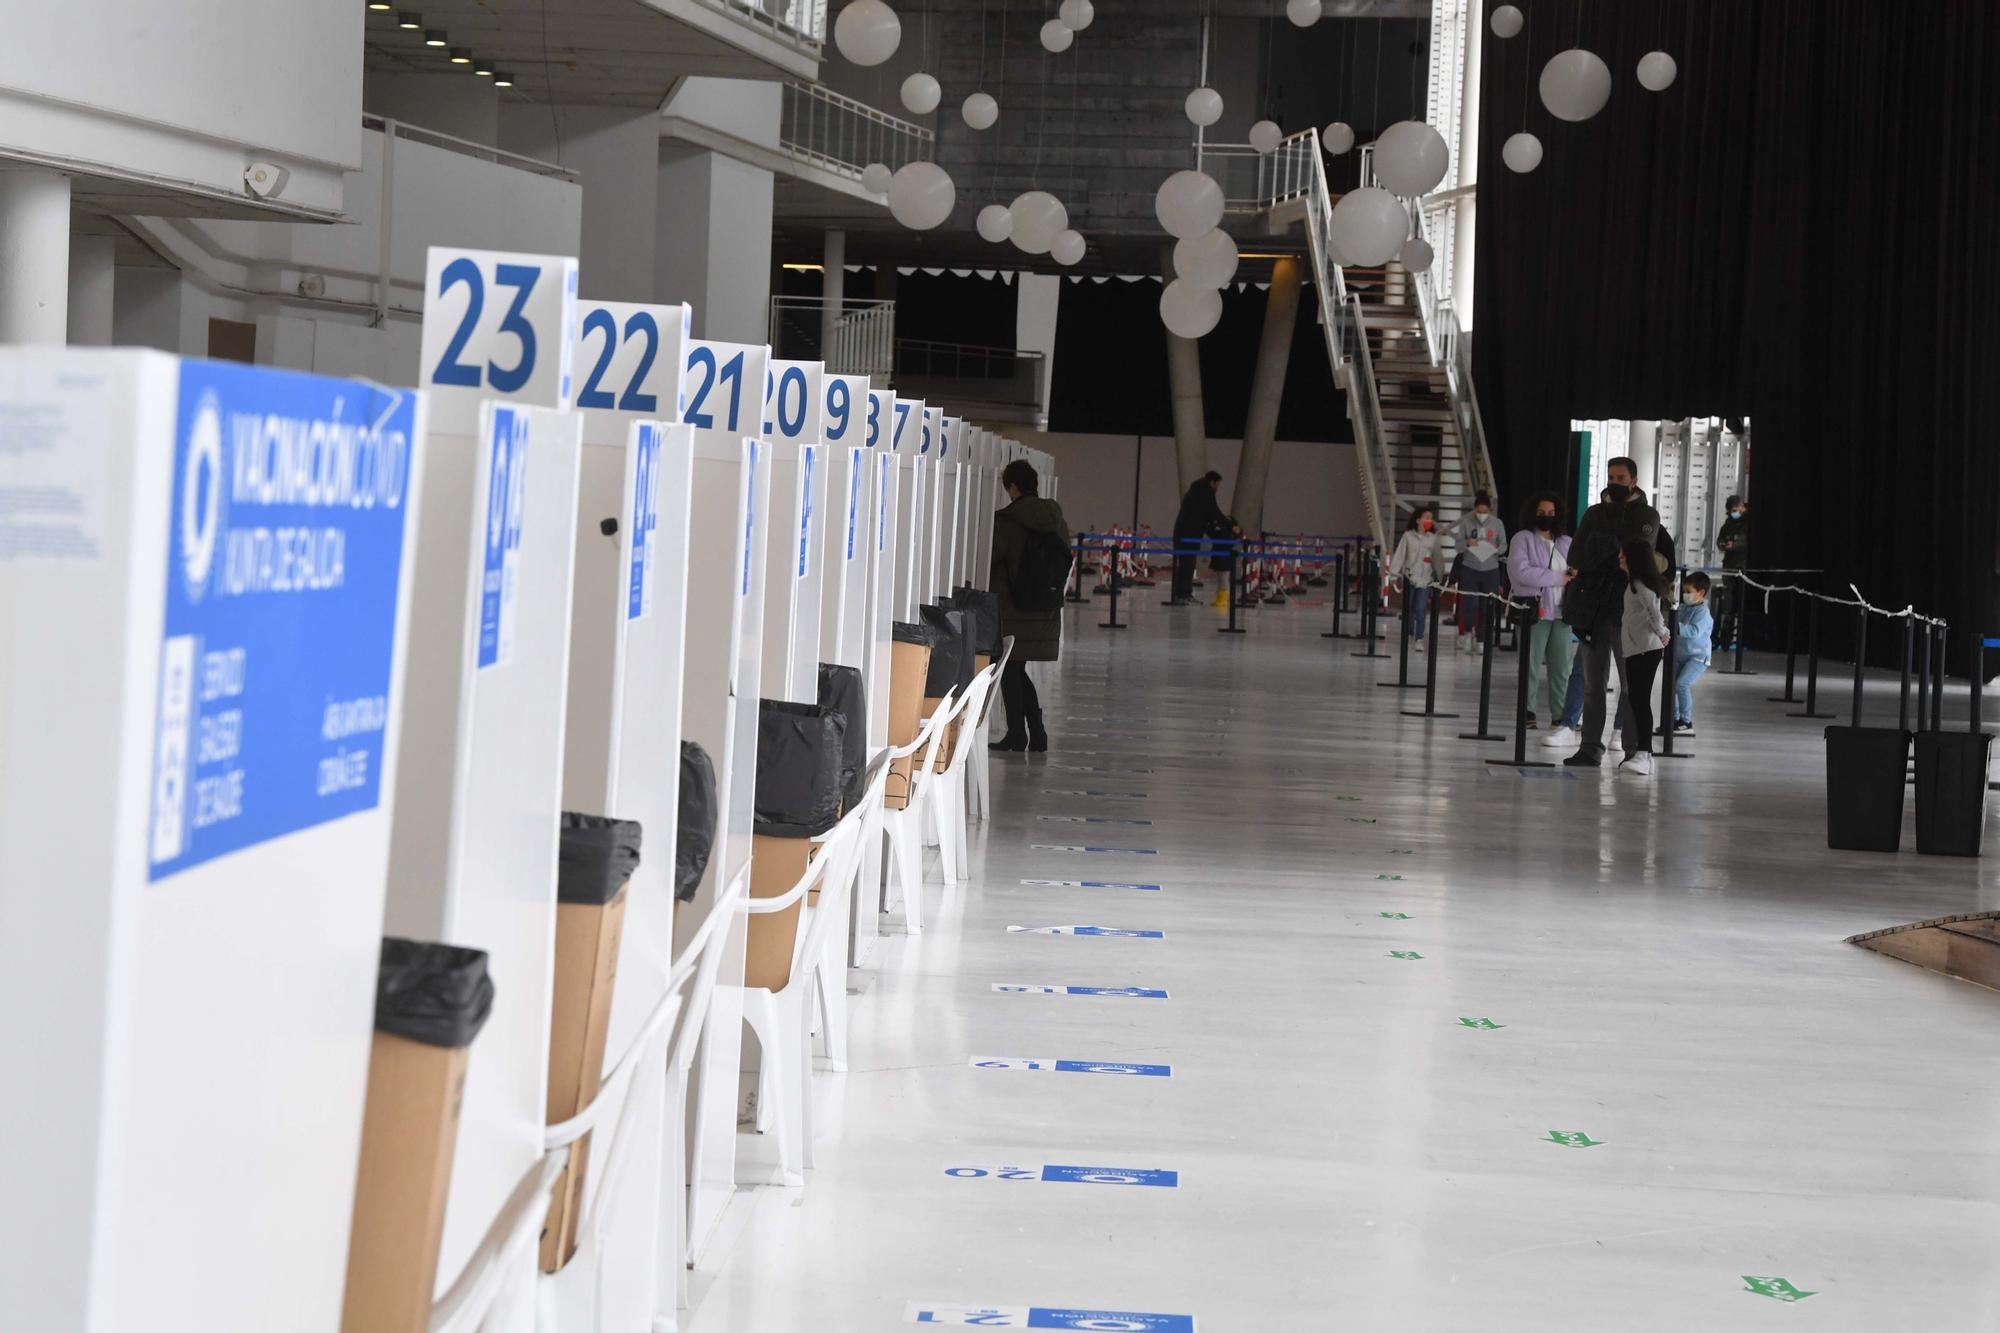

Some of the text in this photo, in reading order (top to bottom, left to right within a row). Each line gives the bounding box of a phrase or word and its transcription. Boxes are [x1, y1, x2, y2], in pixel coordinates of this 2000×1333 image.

[431, 257, 541, 393] 23
[576, 308, 659, 412] 22
[682, 346, 744, 432] 21
[944, 1167, 1036, 1180] 20
[916, 1311, 1013, 1327] 21
